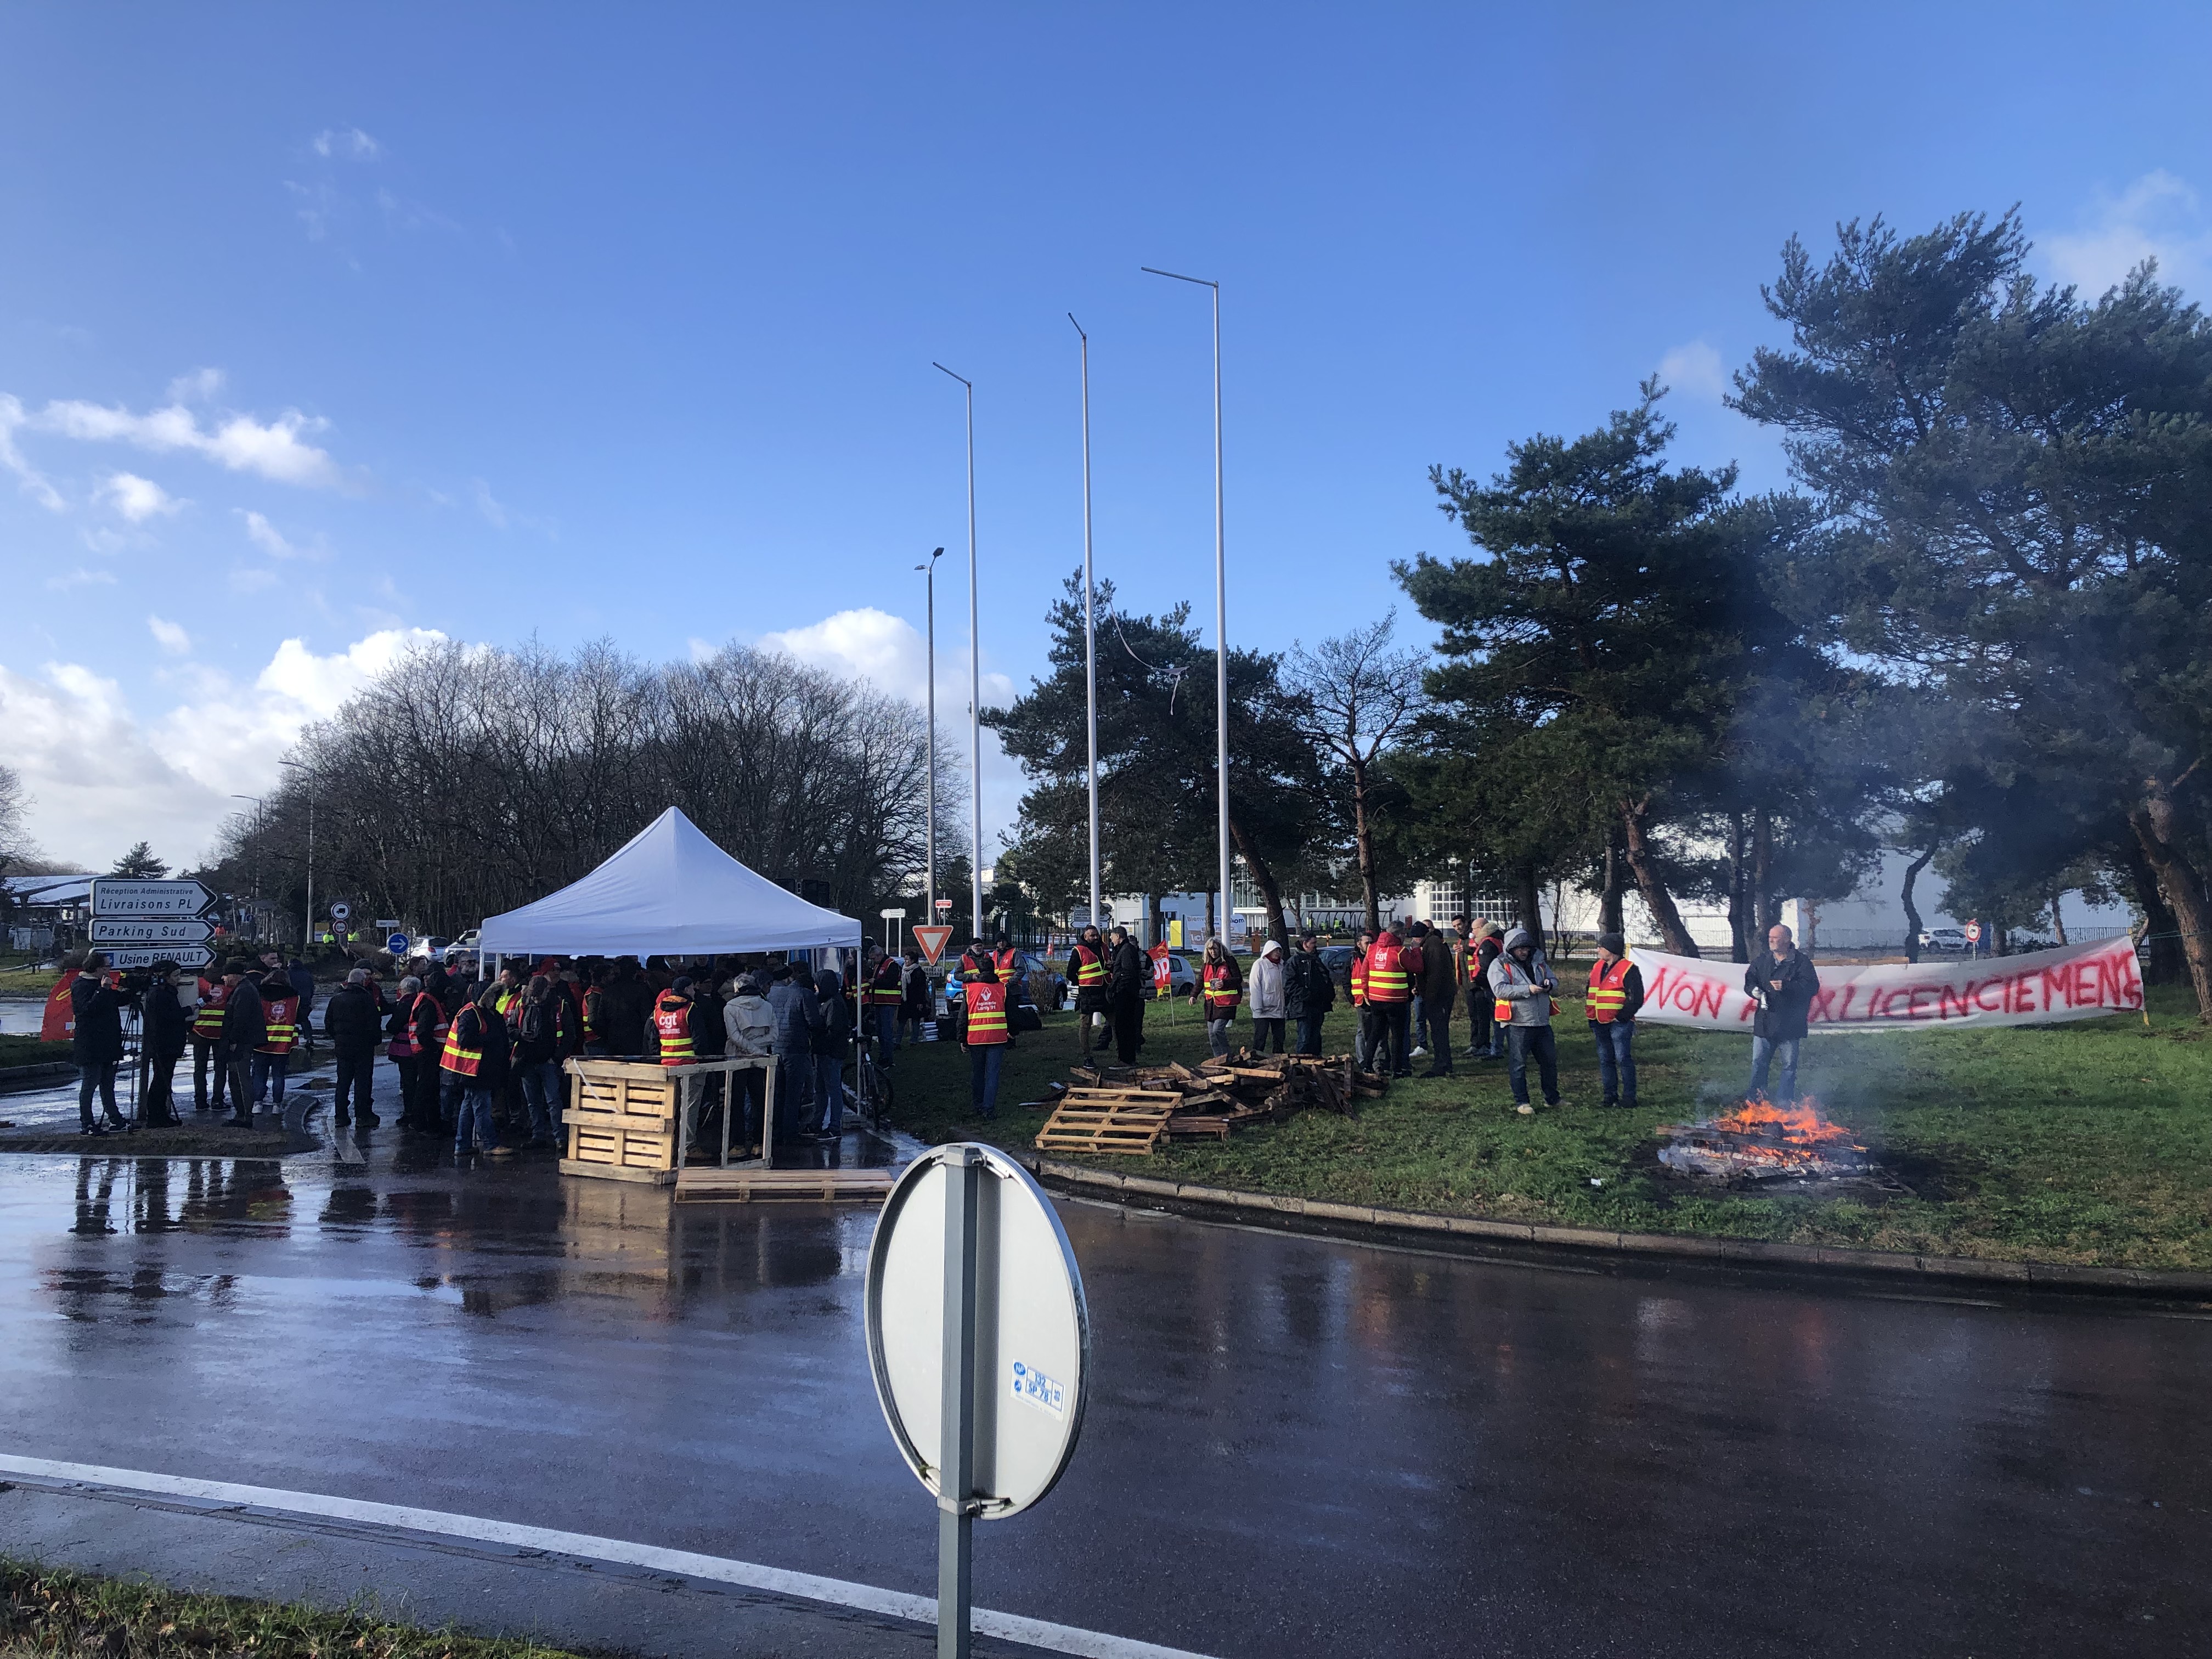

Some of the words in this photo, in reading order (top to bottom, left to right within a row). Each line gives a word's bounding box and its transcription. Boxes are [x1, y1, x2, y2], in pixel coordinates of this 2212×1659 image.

[100, 887, 138, 896] Réception
[100, 899, 171, 909] Livraisons
[178, 899, 193, 909] PL
[99, 926, 153, 939] Parking
[161, 926, 187, 936] Sud
[119, 953, 150, 964] Usine
[1375, 952, 1388, 962] cgt
[1644, 967, 1726, 1020] NON
[659, 1012, 678, 1029] cgt
